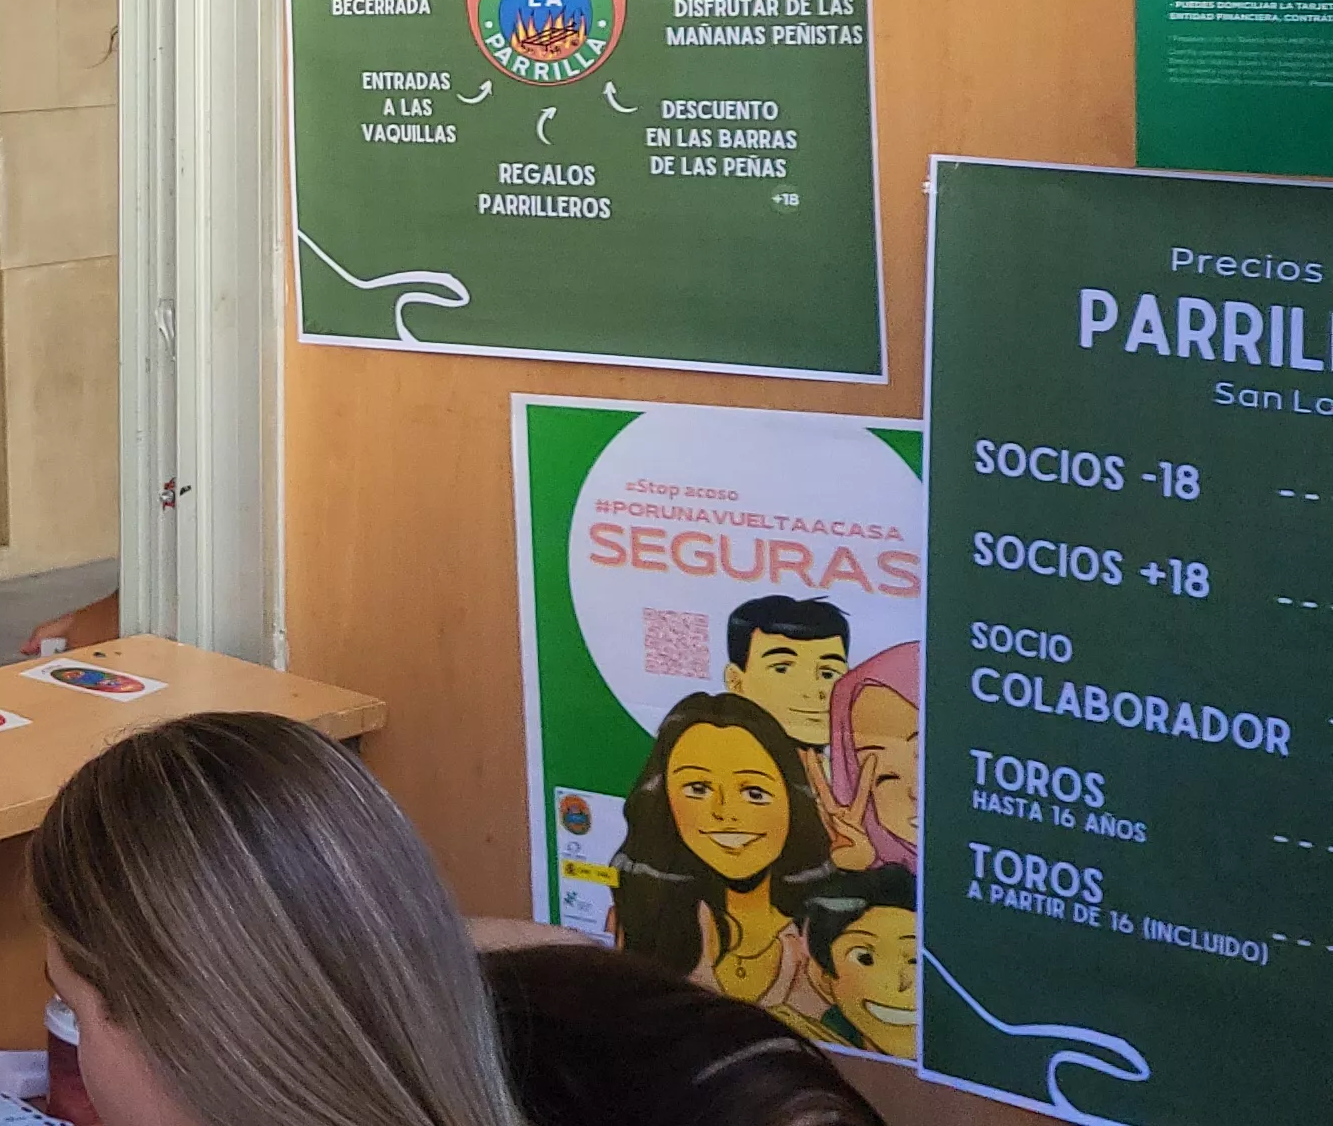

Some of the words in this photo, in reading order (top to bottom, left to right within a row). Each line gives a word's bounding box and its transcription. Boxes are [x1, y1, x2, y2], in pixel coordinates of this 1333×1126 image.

[666, 22, 766, 46] MAÑANAS
[771, 22, 863, 45] PEÑISTAS
[485, 33, 606, 81] PARRILLA
[362, 71, 451, 91] ENTRADAS
[383, 98, 396, 116] A
[400, 98, 433, 117] LAS
[661, 100, 779, 121] DESCUENTO
[360, 123, 457, 144] VAQUILLAS
[646, 127, 671, 147] EN
[676, 128, 713, 148] LAS
[718, 128, 797, 149] BARRAS
[499, 162, 596, 186] REGALOS
[650, 155, 675, 175] DE
[681, 156, 717, 176] LAS
[723, 154, 787, 178] PEÑAS
[478, 193, 611, 219] PARRILLEROS
[772, 193, 800, 206] +18
[1171, 247, 1323, 283] Precios
[1215, 382, 1282, 410] San
[974, 439, 1125, 491] SOCIOS
[1141, 461, 1201, 500] -18
[684, 485, 739, 502] acoso
[595, 499, 904, 542] #PORUNAVUELTAACASA
[589, 523, 923, 598] SEGURAS
[973, 531, 1123, 586] SOCIOS
[1139, 559, 1210, 598] +18
[971, 621, 1073, 663] SOCIO
[970, 667, 1291, 758] COLABORADOR
[970, 749, 1106, 808] TOROS
[972, 790, 1044, 822] HASTA
[1052, 805, 1077, 831] 16
[1083, 808, 1147, 844] AÑOS
[968, 843, 1104, 904] TOROS
[968, 882, 982, 902] A
[990, 886, 1066, 920] PARTIR
[1073, 902, 1102, 929] DE
[1110, 909, 1134, 935] 16
[1143, 915, 1269, 966] (INCLUIDO)
